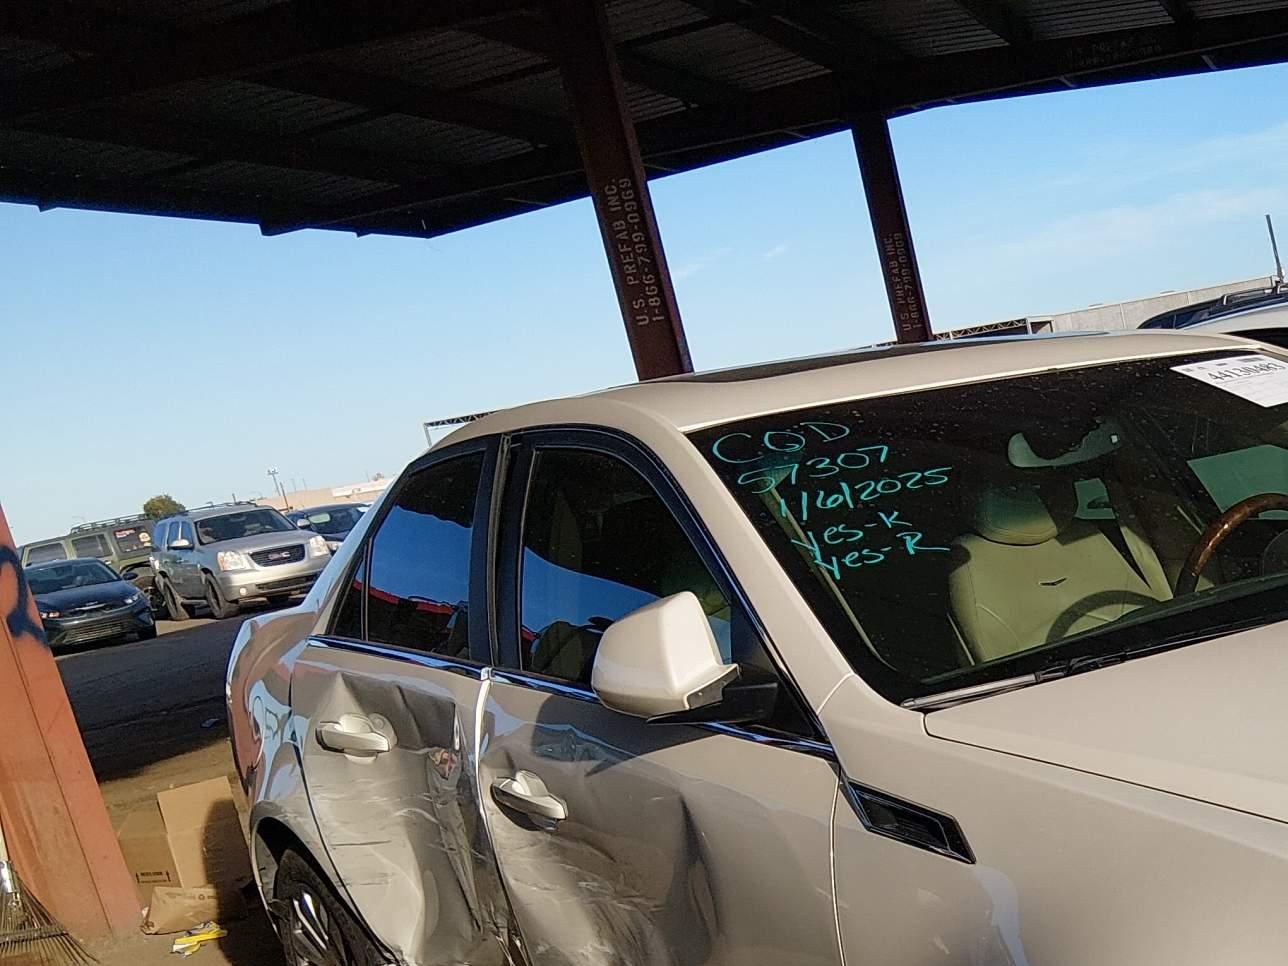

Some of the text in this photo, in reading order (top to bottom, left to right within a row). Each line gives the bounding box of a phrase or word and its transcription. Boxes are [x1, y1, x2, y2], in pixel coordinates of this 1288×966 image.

[604, 178, 650, 325] U.S. PREFAB INC.
[618, 178, 665, 321] 1-866-799-0969
[737, 446, 888, 493] 57307
[780, 467, 952, 520] 1/6/2025
